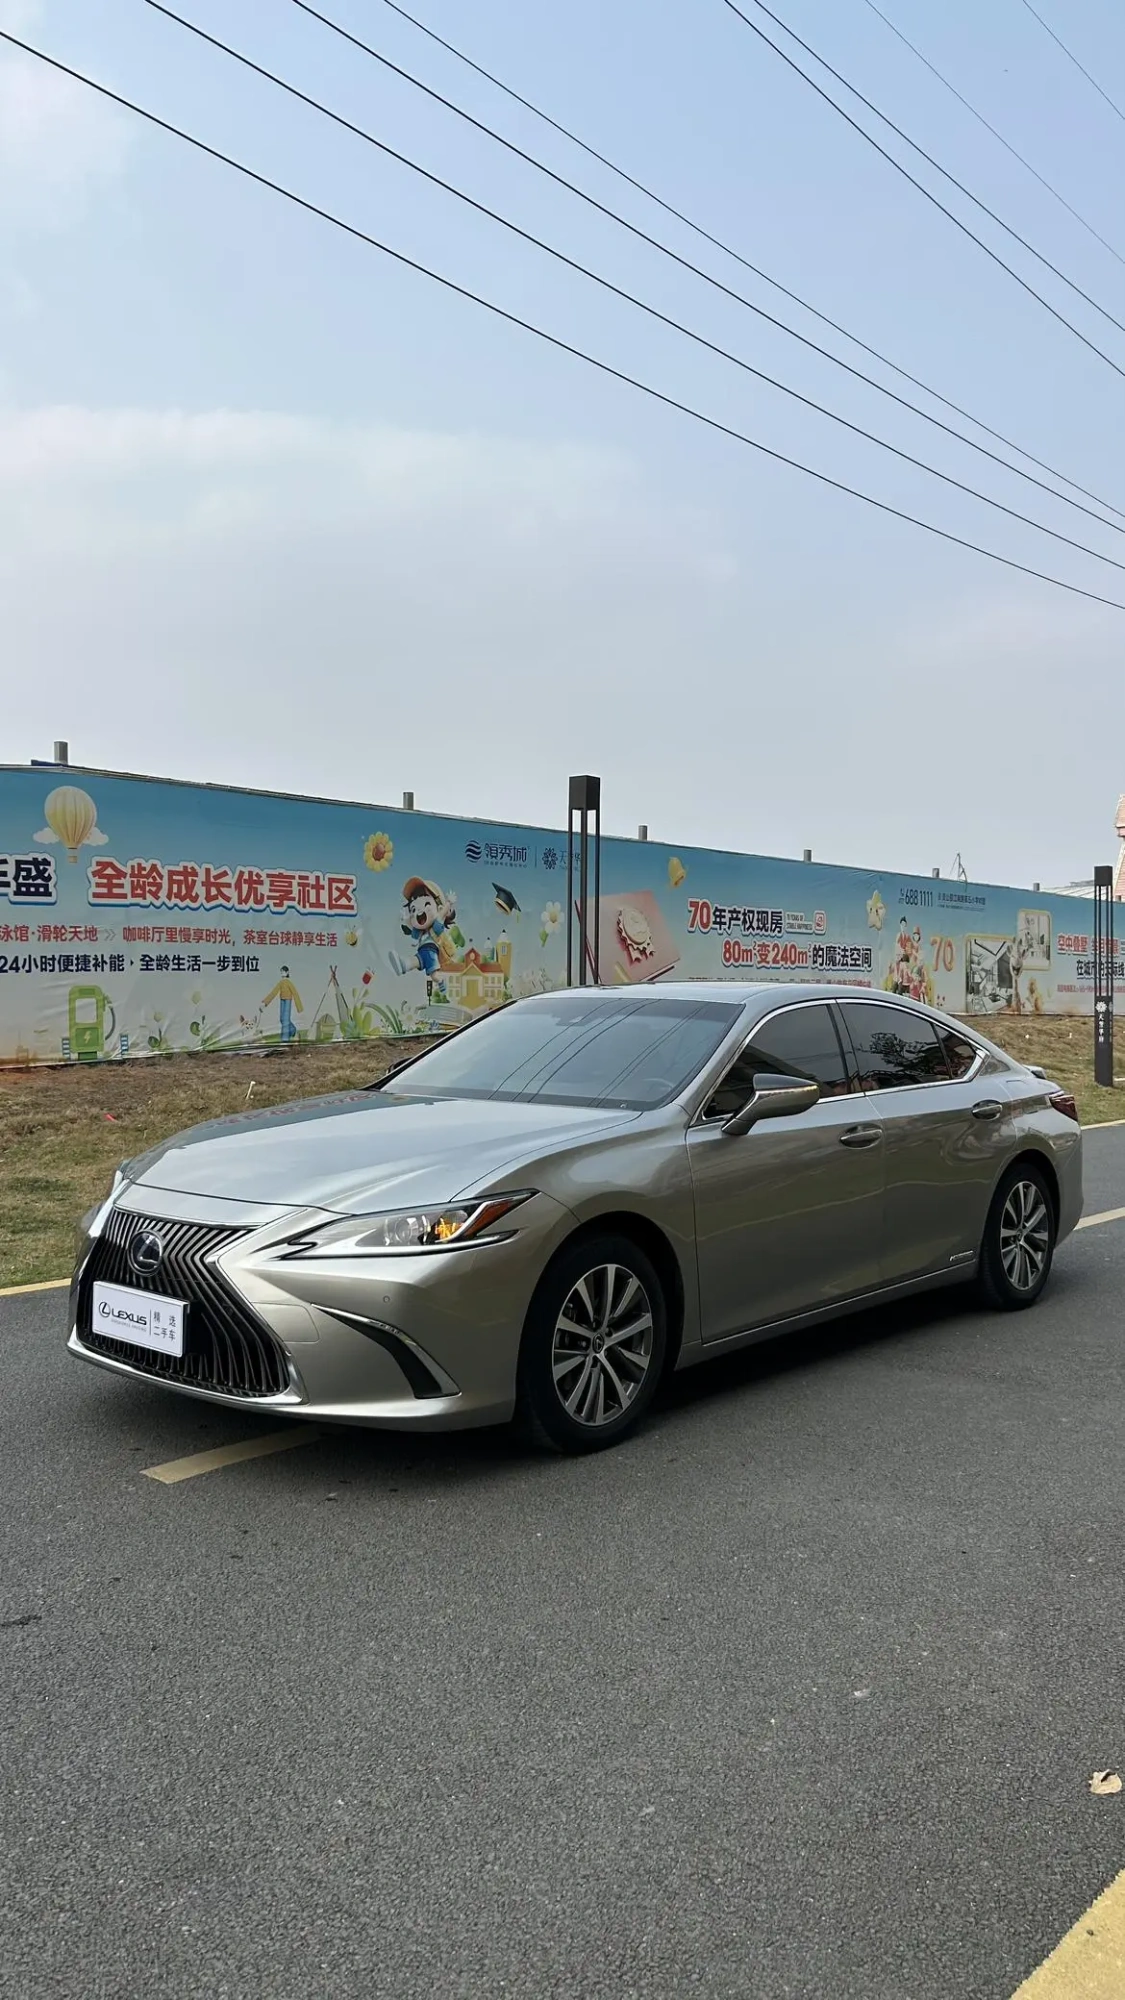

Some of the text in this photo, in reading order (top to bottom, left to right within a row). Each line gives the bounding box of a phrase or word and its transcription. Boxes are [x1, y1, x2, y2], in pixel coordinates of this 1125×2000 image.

[91, 860, 356, 911] 全龄成长优享社区
[688, 900, 783, 934] 70年产权现房
[139, 954, 260, 972] 全龄生活一步到位
[111, 1308, 147, 1325] LEXUS
